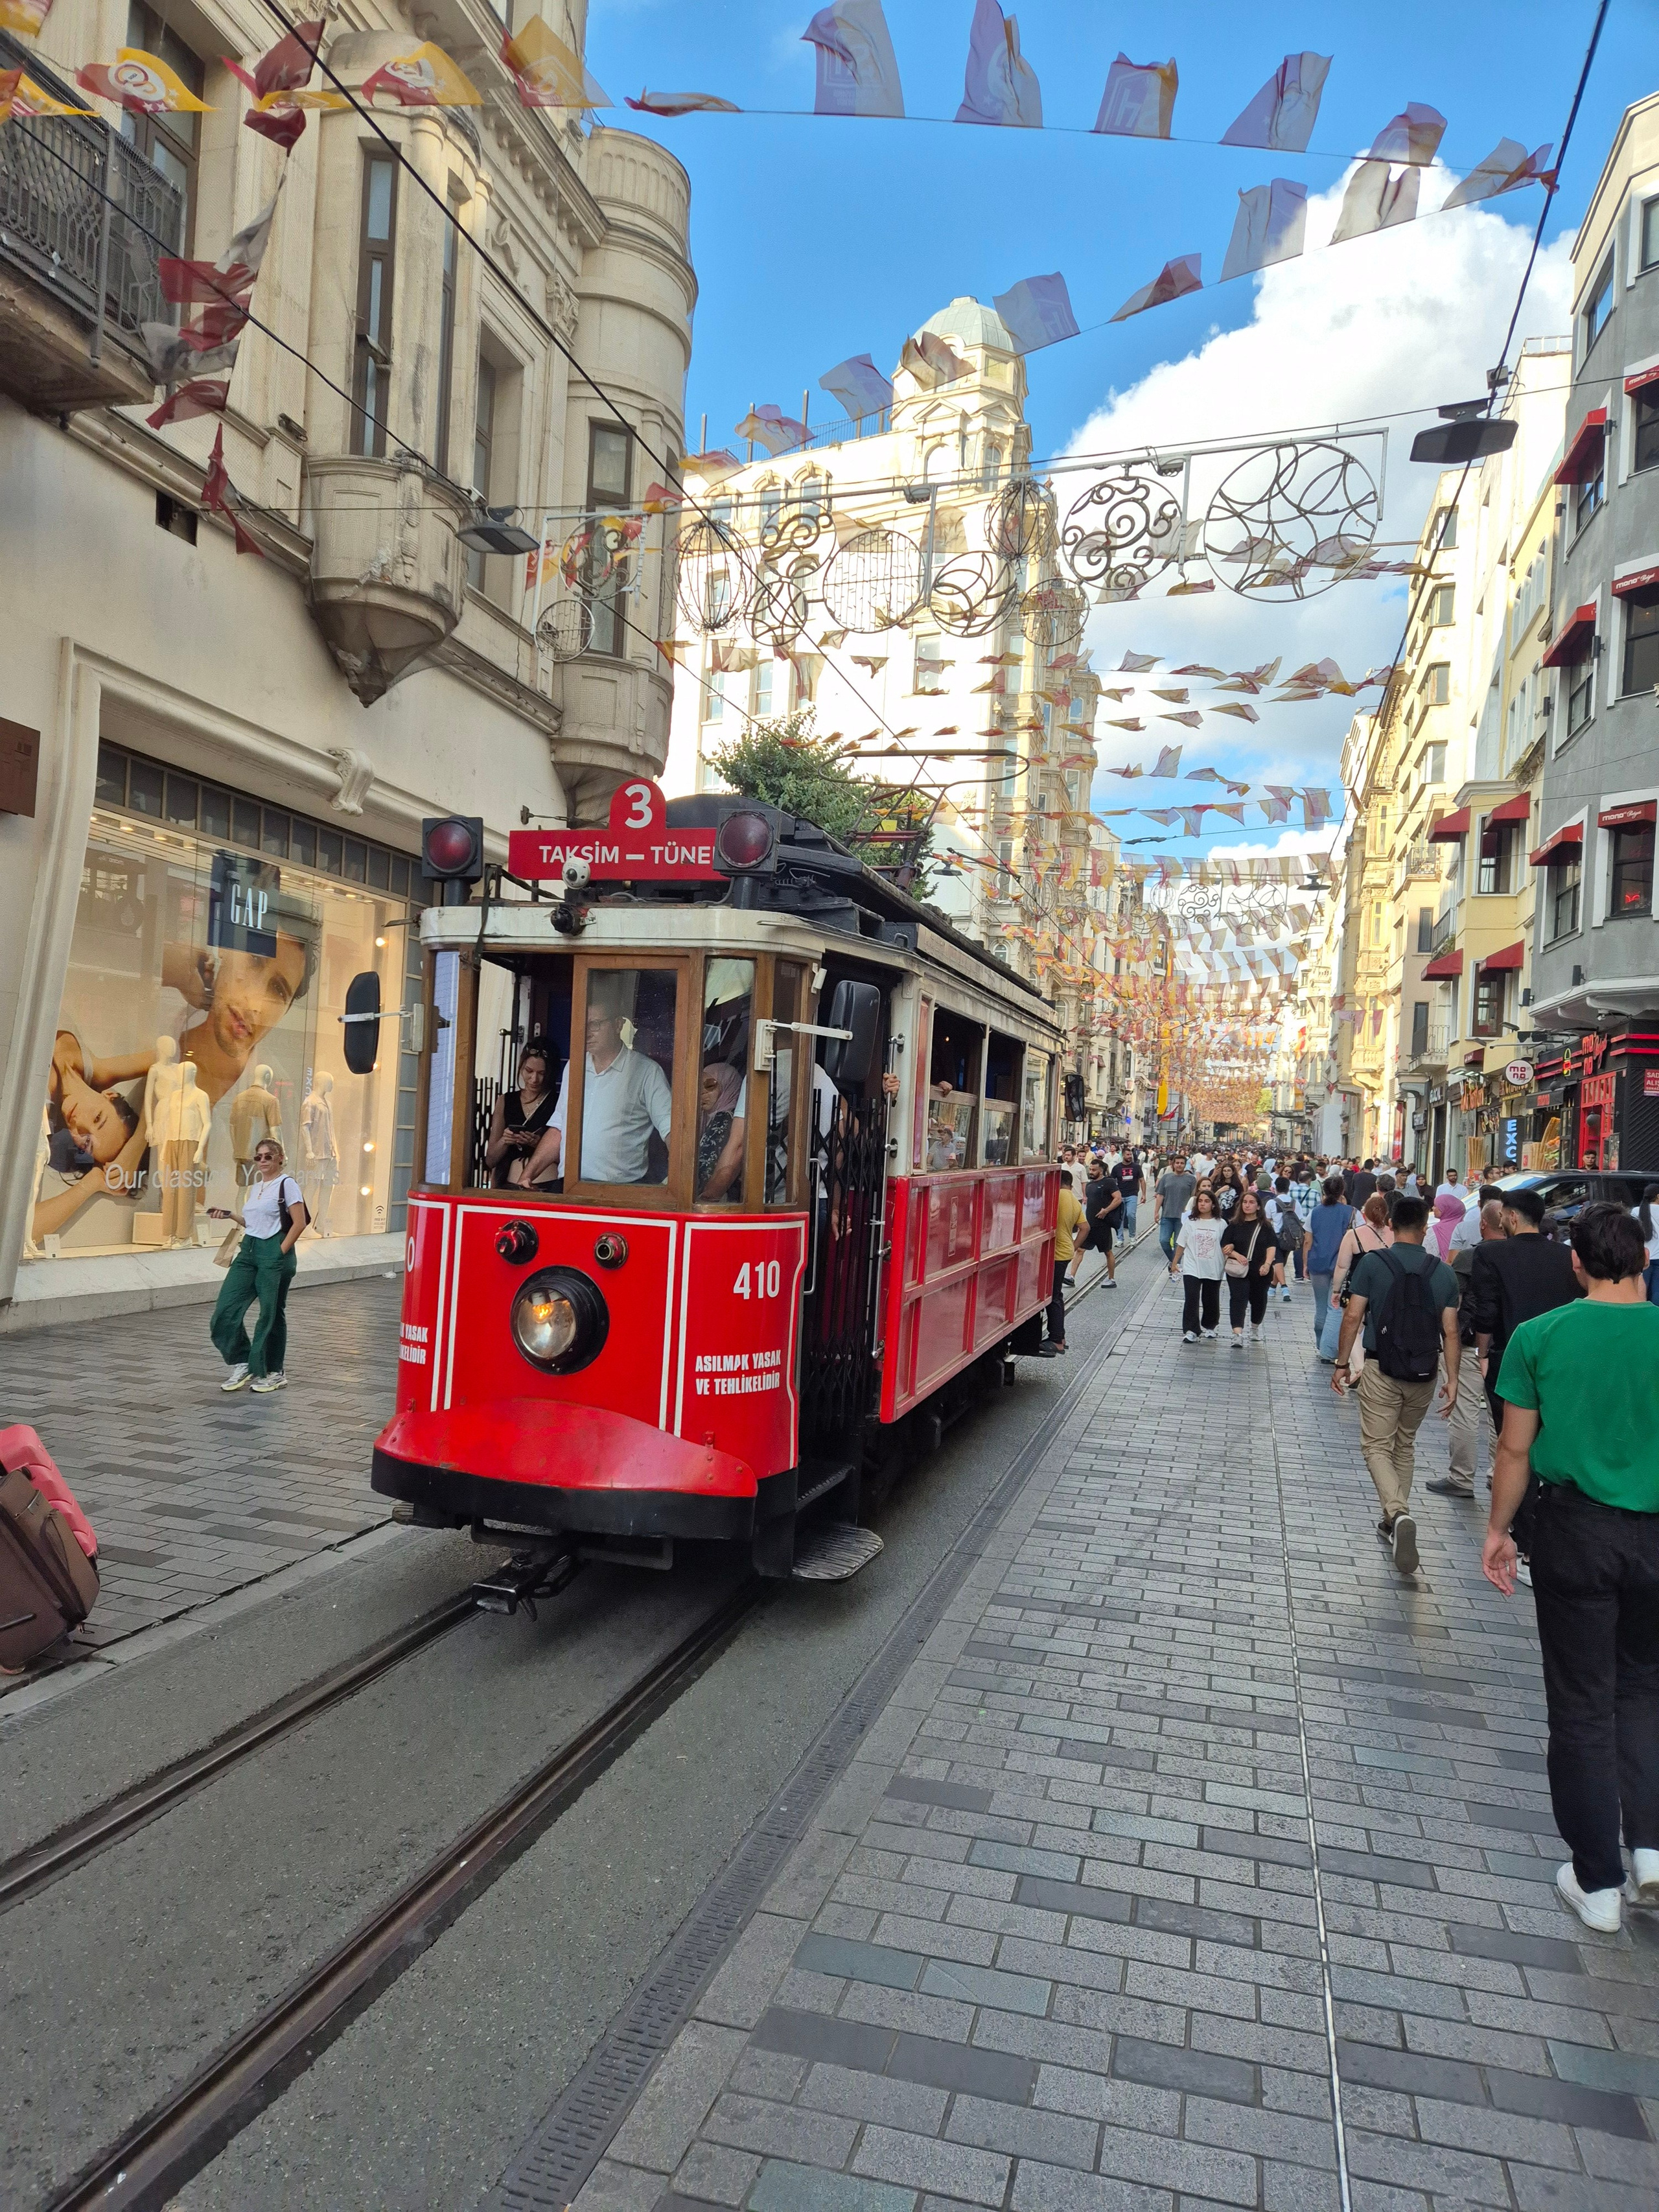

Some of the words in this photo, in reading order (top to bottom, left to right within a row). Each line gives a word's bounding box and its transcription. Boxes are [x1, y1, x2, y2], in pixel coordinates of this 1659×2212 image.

[1616, 578, 1638, 589] mono
[624, 784, 653, 828] 3
[1602, 813, 1624, 821] mono
[539, 841, 620, 864] TAKSİM
[651, 841, 715, 865] TÜNE
[231, 883, 268, 930] GAP
[1505, 1119, 1518, 1163] EXC
[106, 1163, 148, 1190] Our
[733, 1260, 780, 1299] 410
[405, 1323, 429, 1344] YASAK
[695, 1354, 749, 1372] ASILMAK
[752, 1349, 782, 1369] YASAK
[695, 1378, 710, 1395] VE
[713, 1370, 780, 1395] TEHLİKELİDİR
